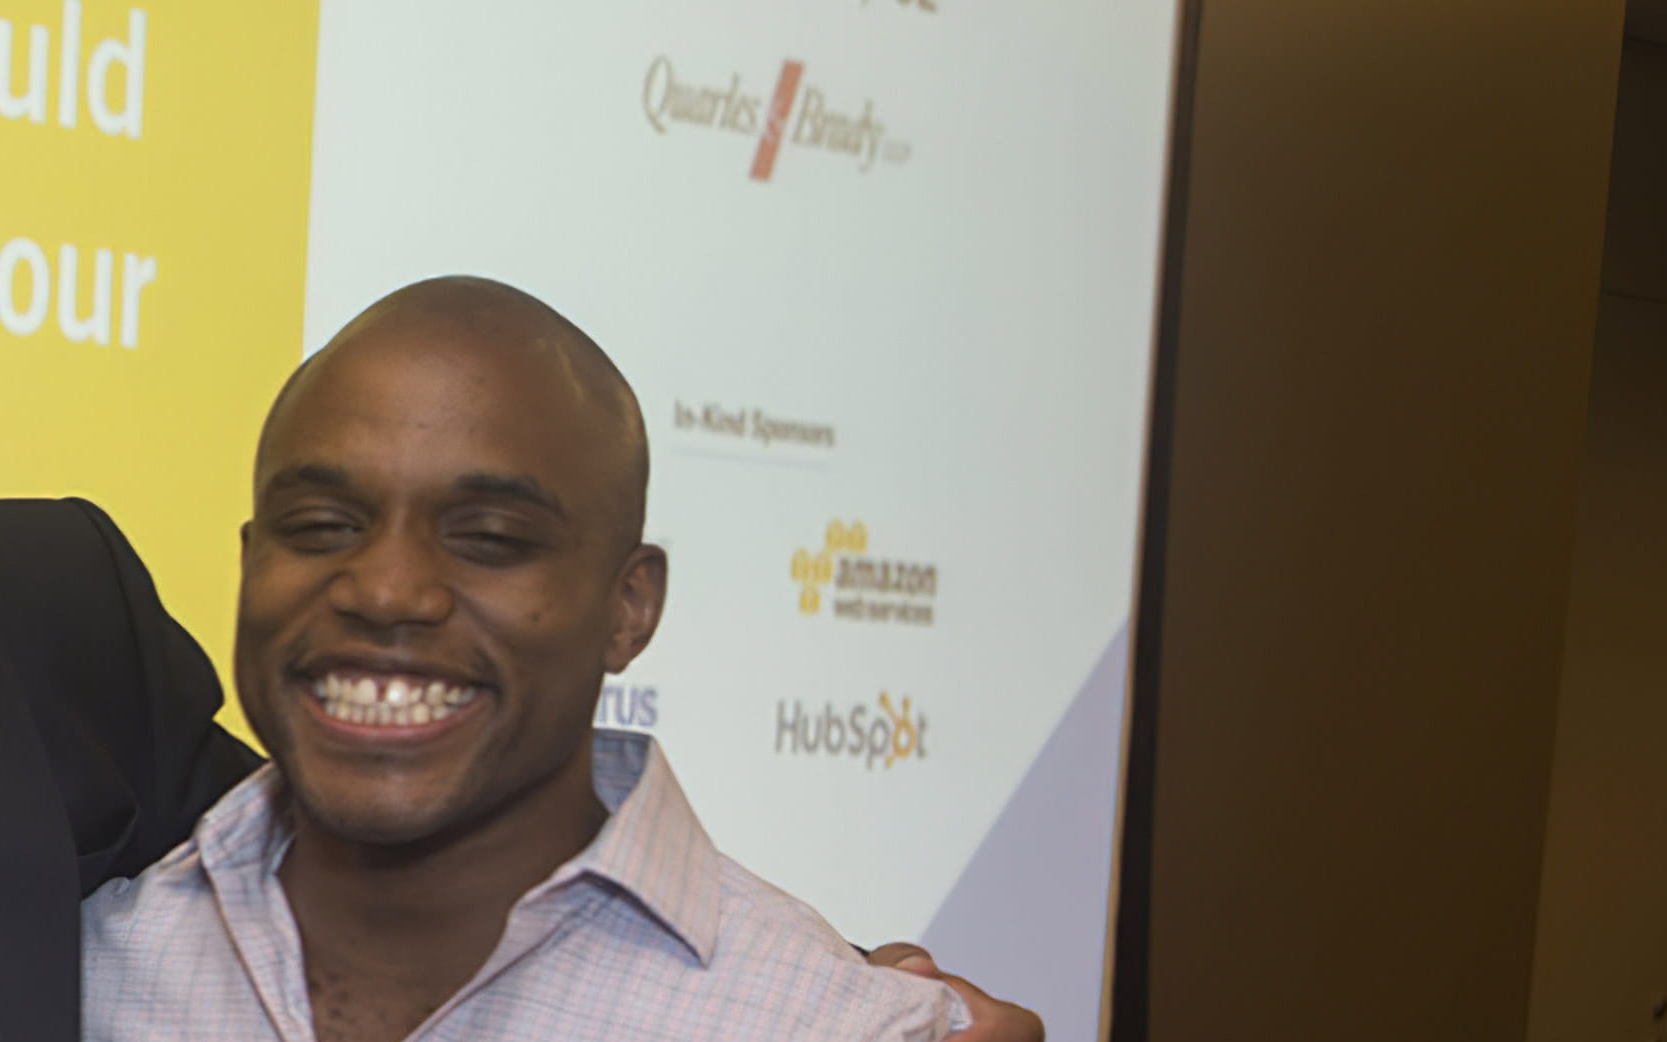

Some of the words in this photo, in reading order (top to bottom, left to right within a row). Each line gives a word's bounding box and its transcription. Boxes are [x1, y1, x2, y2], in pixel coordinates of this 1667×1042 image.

[752, 406, 837, 449] Sponsors
[834, 556, 938, 597] amazon
[775, 691, 929, 770] HubSpot
